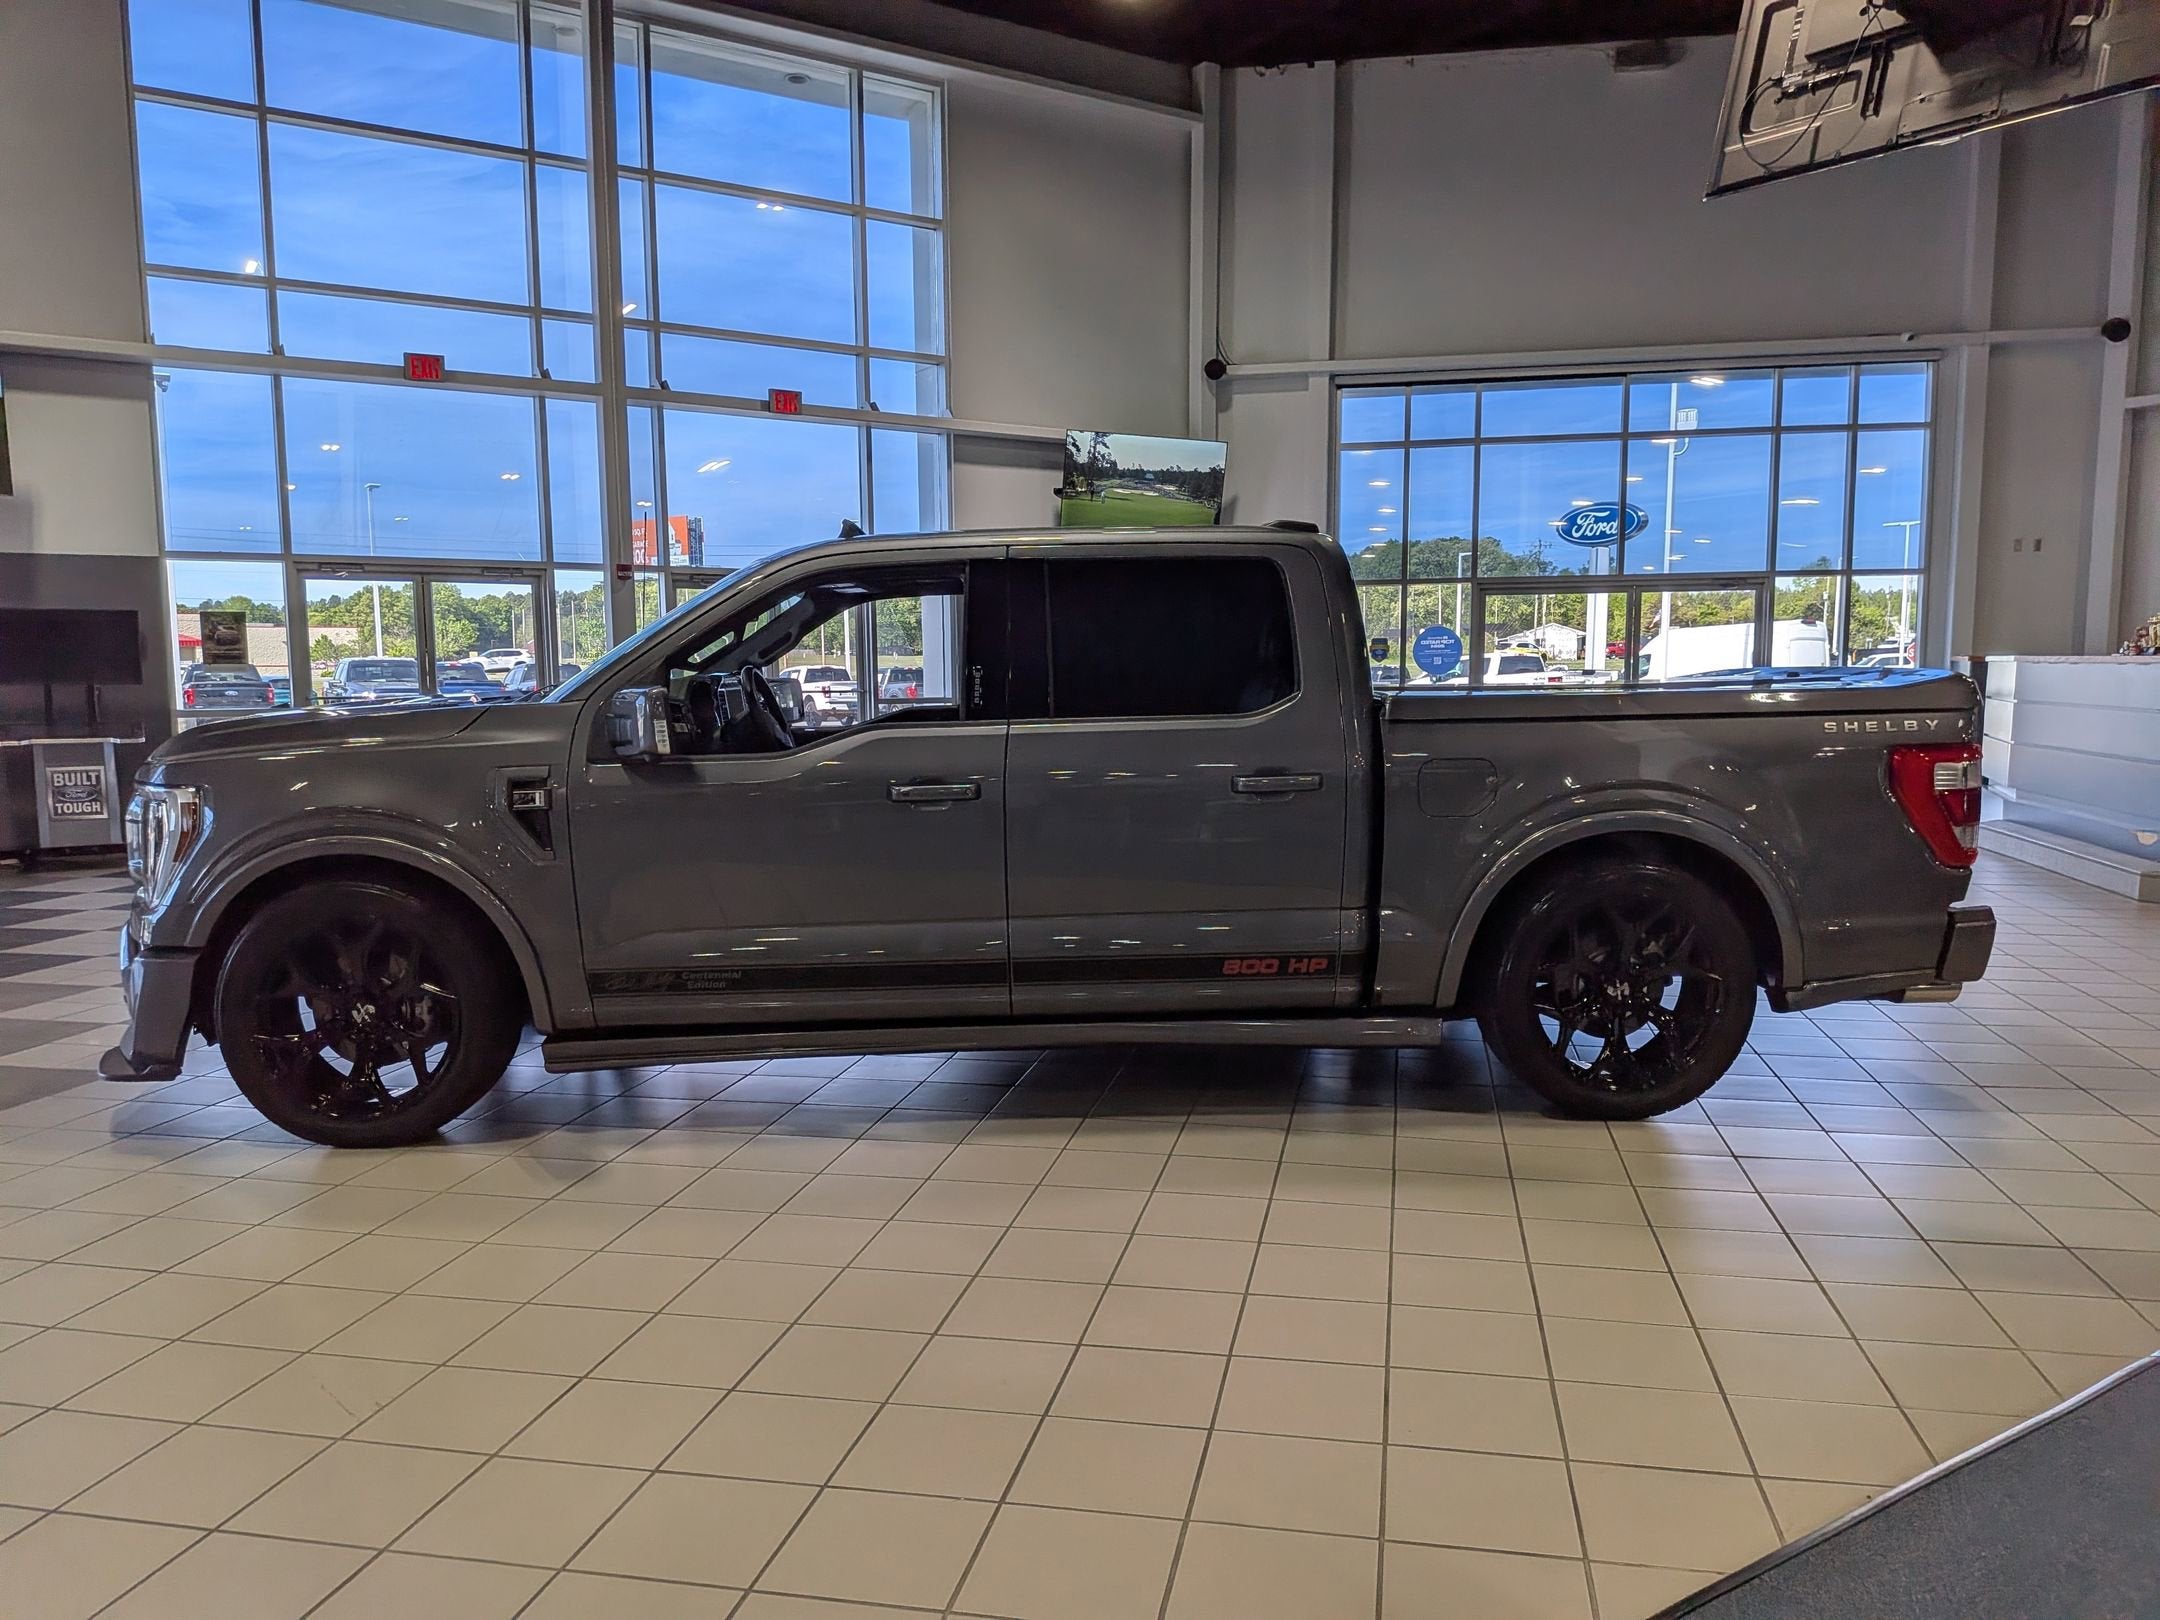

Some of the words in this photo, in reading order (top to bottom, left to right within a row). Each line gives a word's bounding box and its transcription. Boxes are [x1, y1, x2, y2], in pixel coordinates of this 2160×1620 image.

[411, 355, 440, 379] EXIT
[774, 391, 799, 413] EXIT
[1571, 511, 1619, 538] Ford
[1823, 719, 1939, 733] SHELBY
[53, 771, 99, 787] BUILT
[55, 801, 101, 814] TOUGH
[1222, 958, 1280, 975] 800
[1287, 957, 1329, 974] HP
[681, 970, 742, 980] Centennial
[687, 981, 727, 989] Edition
